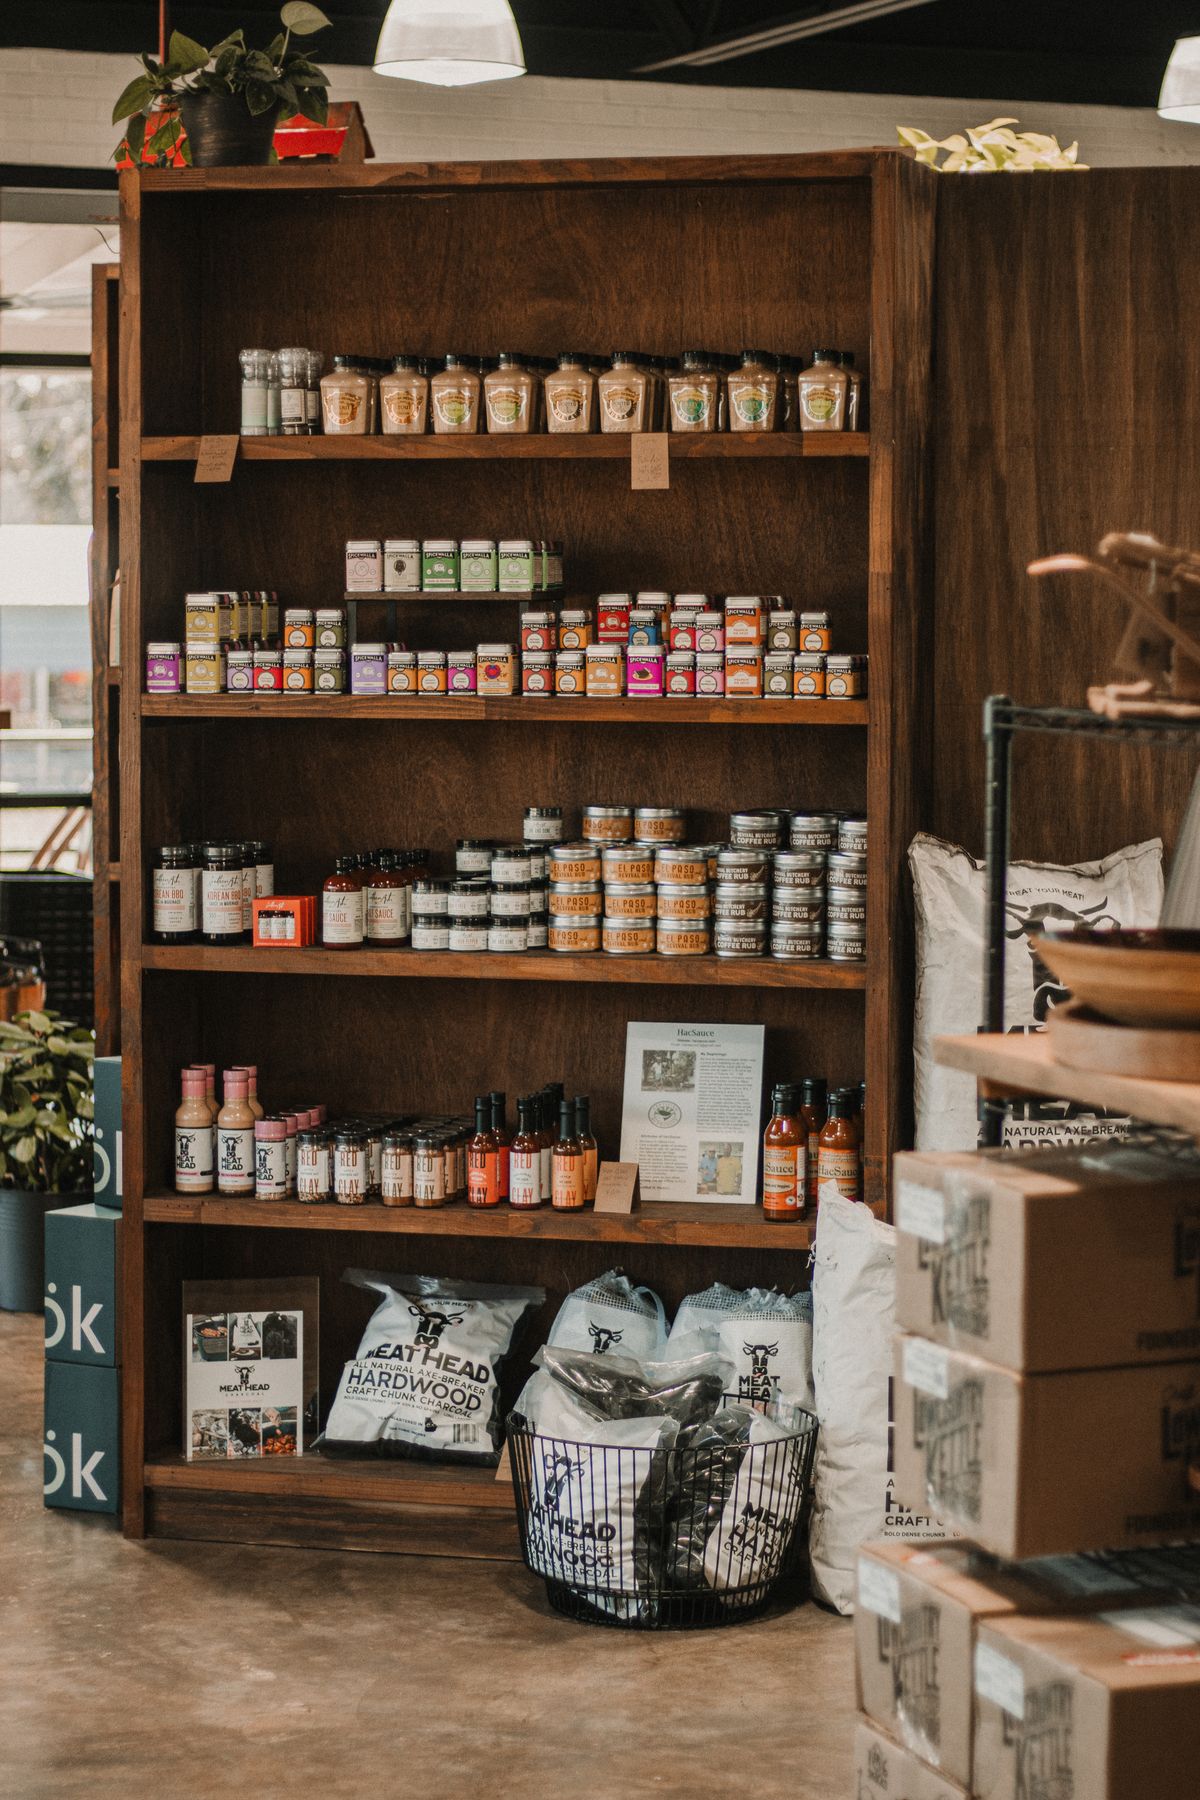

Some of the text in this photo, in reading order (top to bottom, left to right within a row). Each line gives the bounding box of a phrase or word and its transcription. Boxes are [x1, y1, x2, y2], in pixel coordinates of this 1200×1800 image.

[1009, 887, 1033, 896] REAT
[374, 909, 393, 919] SAUCE
[677, 1028, 715, 1037] HacSauce
[1004, 1124, 1130, 1137] NATURAL AXE-BREAK
[300, 1150, 317, 1166] RED
[340, 1151, 357, 1167] RED
[514, 1152, 532, 1168] RED
[765, 1162, 794, 1173] Sauce
[818, 1165, 857, 1176] HacSauc
[365, 1343, 490, 1384] MEAT HEAD
[353, 1361, 486, 1396] ALL NATURAL AXE-BREAKER
[738, 1375, 781, 1387] MEAT
[347, 1368, 482, 1411] HARDWOOD
[738, 1387, 771, 1401] HEA
[345, 1385, 473, 1419] CRAFT CHUNK CHARCOAL
[885, 1515, 931, 1526] CRAFT
